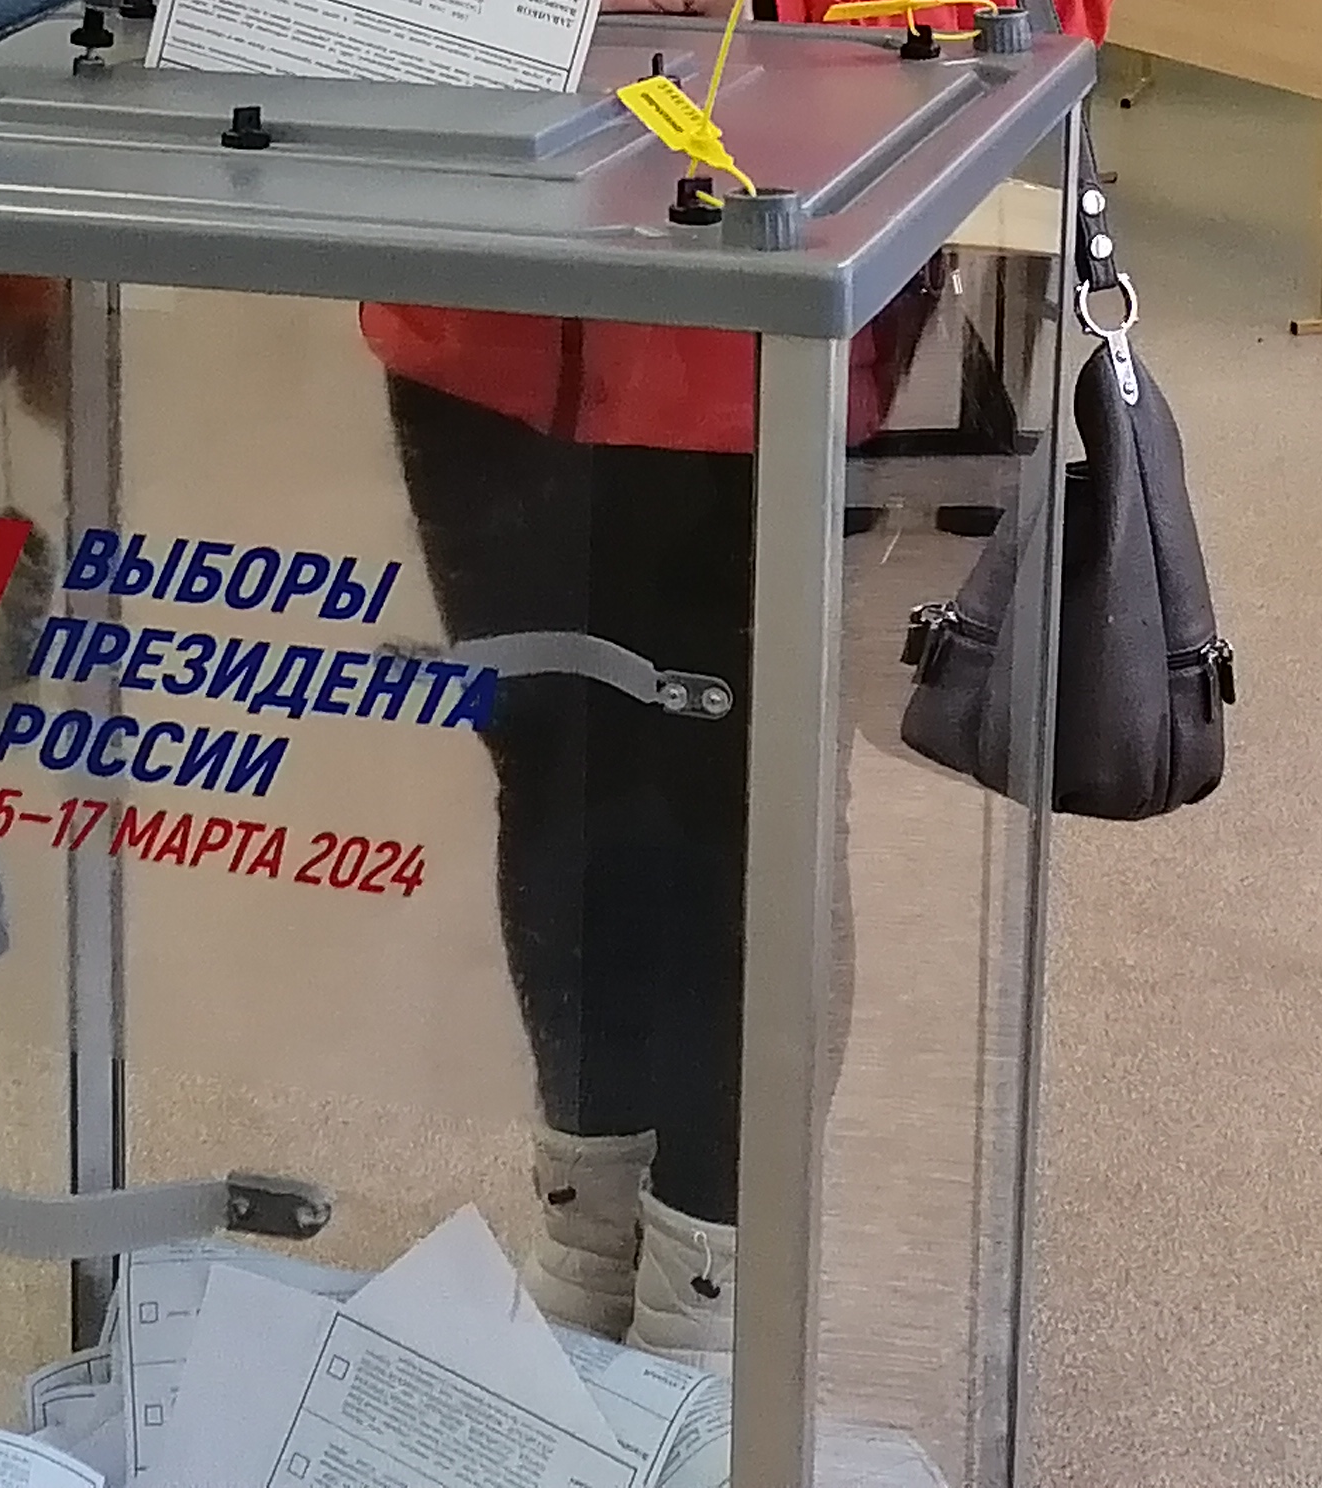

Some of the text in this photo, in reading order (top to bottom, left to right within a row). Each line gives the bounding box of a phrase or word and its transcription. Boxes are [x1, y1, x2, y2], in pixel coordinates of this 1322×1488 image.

[63, 527, 403, 625] ВЫБОРЫ
[28, 616, 499, 732] ПРЕЗИДЕНТА
[110, 805, 287, 880] МАРТА
[295, 831, 425, 897] 2024
